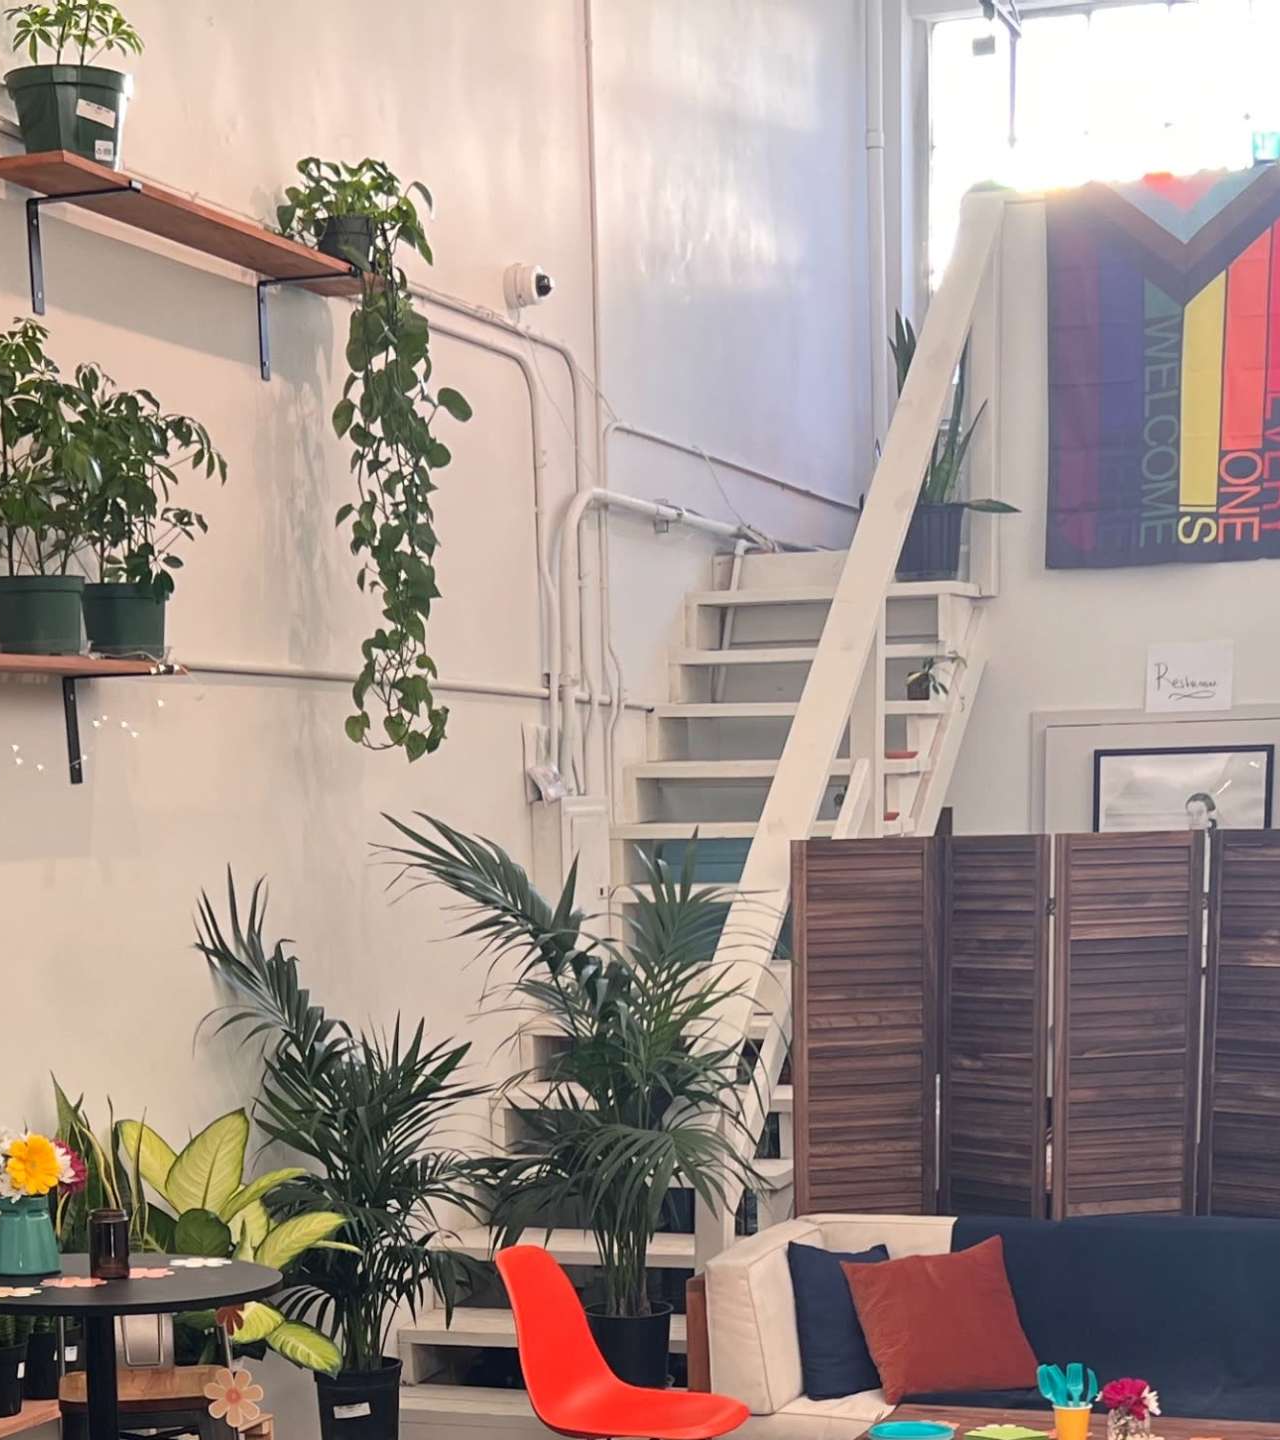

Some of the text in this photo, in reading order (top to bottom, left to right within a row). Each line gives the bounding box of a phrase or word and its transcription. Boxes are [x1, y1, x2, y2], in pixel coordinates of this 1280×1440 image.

[1140, 316, 1182, 547] WELCOME
[1178, 506, 1218, 544] IS
[1217, 450, 1262, 543] ONE
